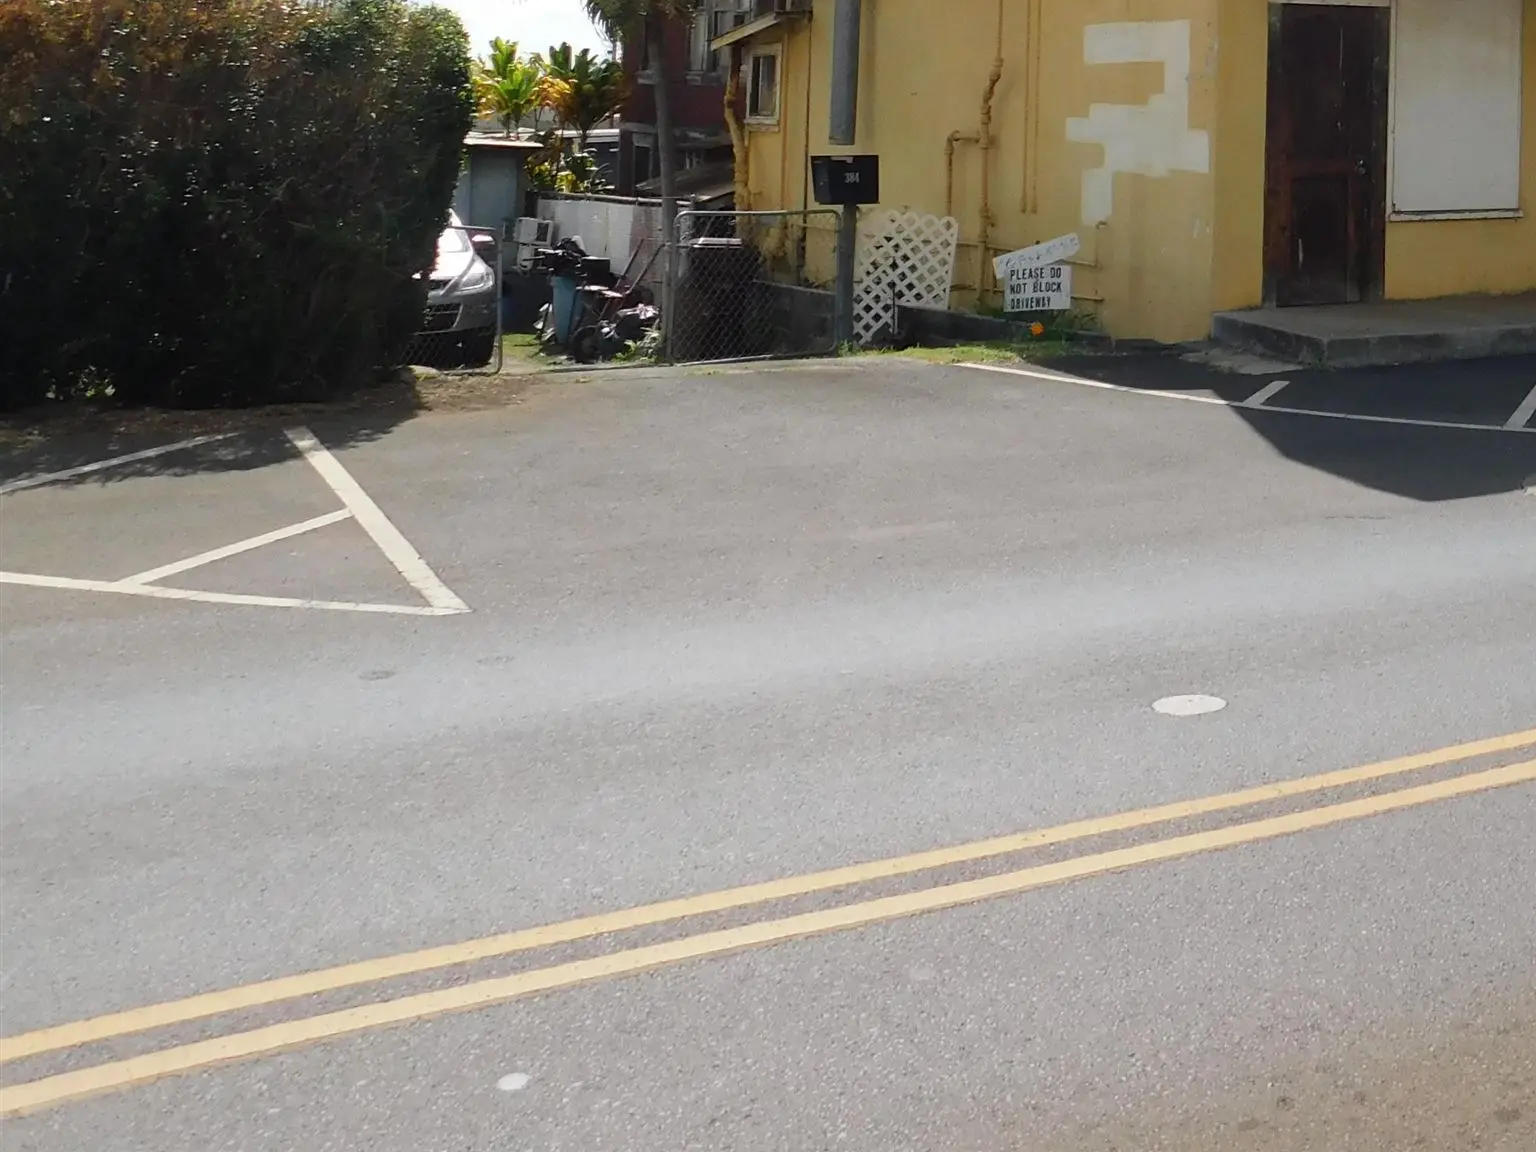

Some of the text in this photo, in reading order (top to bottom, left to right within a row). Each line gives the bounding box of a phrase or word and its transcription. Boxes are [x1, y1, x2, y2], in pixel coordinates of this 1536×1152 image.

[844, 171, 860, 184] 384
[1009, 267, 1062, 281] PLEASE DO
[1009, 282, 1063, 295] NOT BLOCK
[1010, 296, 1051, 309] DRIVEWAY
